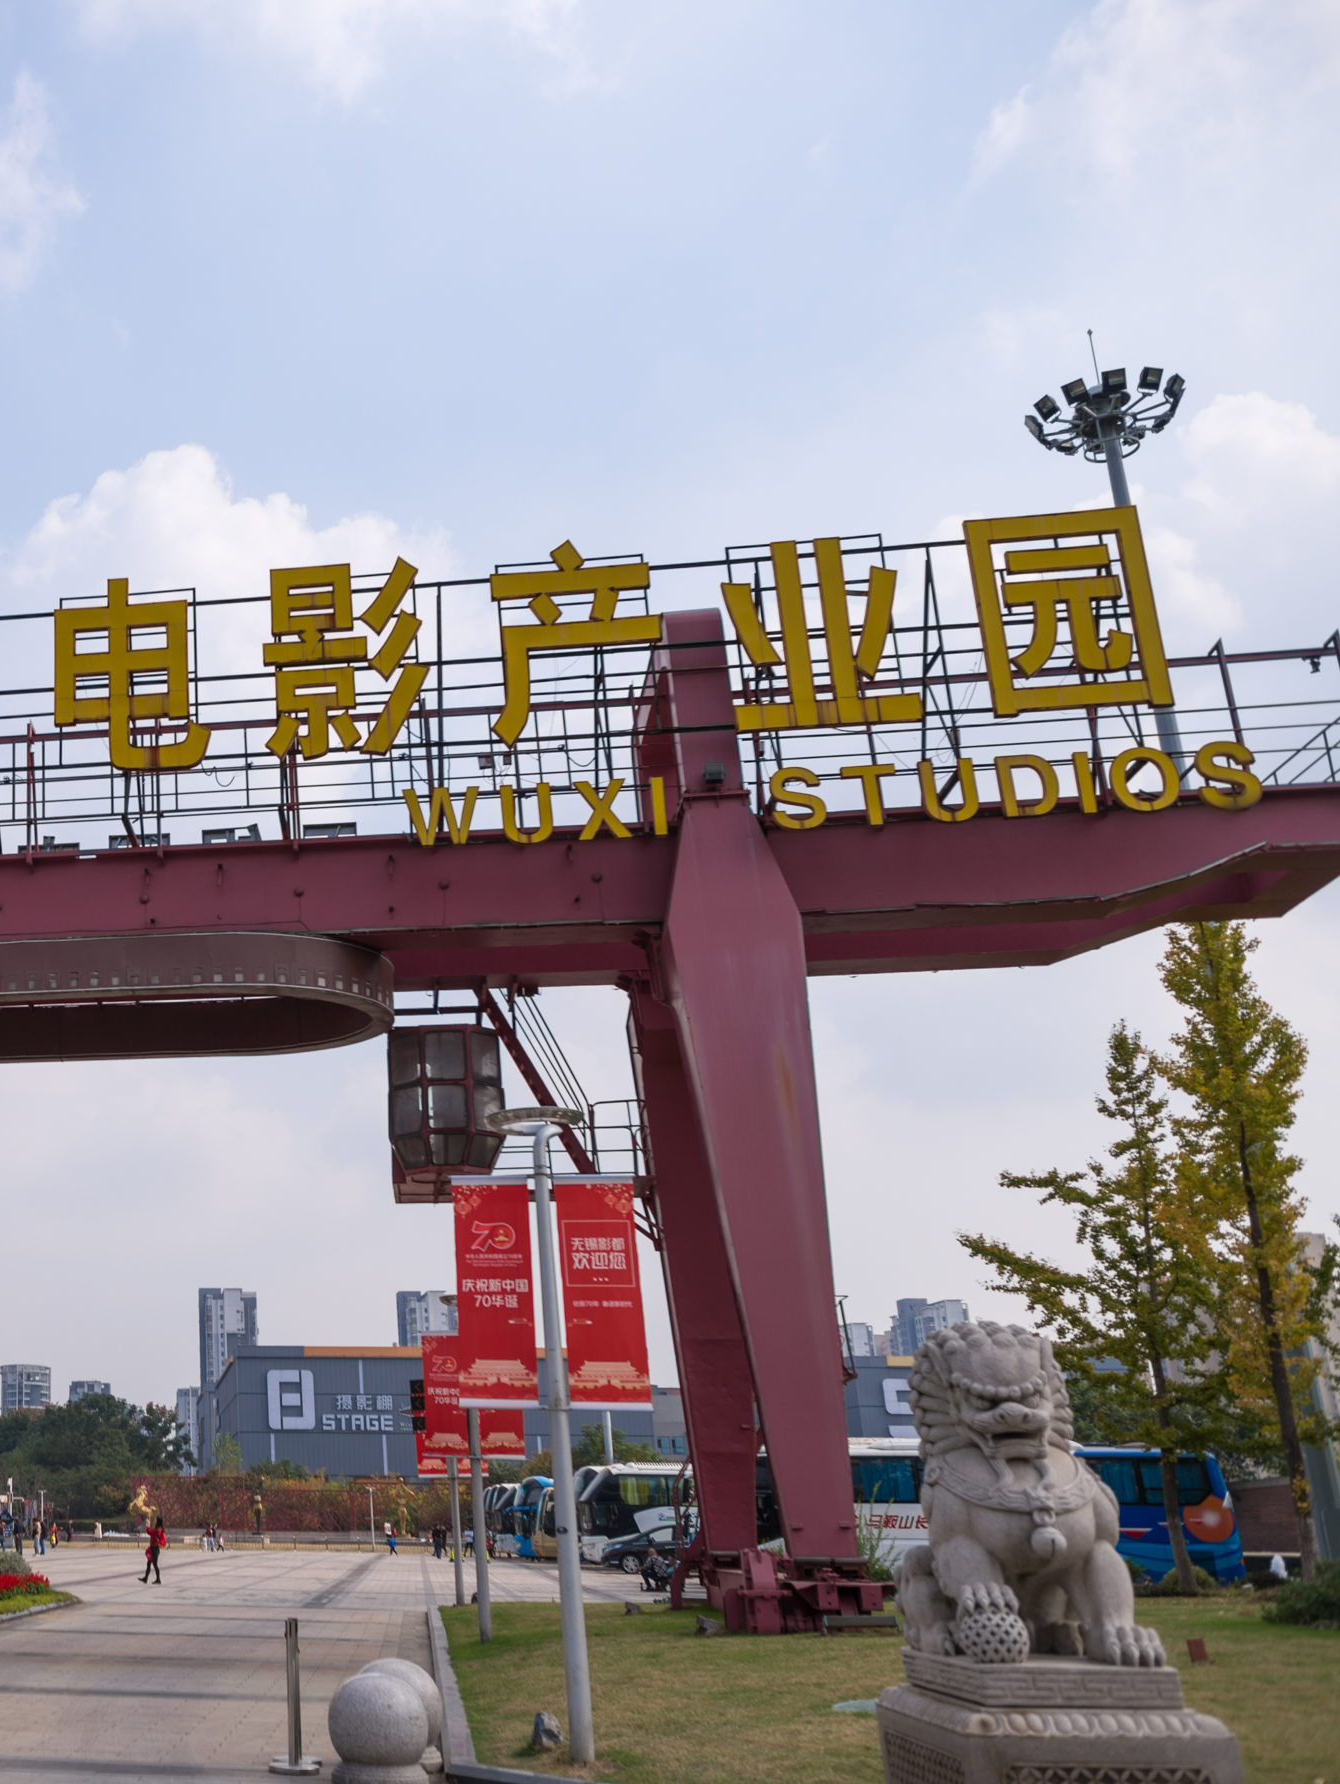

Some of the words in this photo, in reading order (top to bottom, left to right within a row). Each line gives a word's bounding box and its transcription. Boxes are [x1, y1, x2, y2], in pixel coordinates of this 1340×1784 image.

[403, 776, 667, 847] WUXI
[769, 740, 1263, 830] STUDIOS
[570, 1237, 626, 1251] 无锡影都
[571, 1252, 627, 1270] 欢迎您
[461, 1278, 529, 1293] 庆祝新中国
[473, 1294, 519, 1308] 70华诞
[427, 1387, 460, 1396] 庆祝新中
[335, 1394, 393, 1411] 摄影棚
[322, 1414, 394, 1431] STAGE
